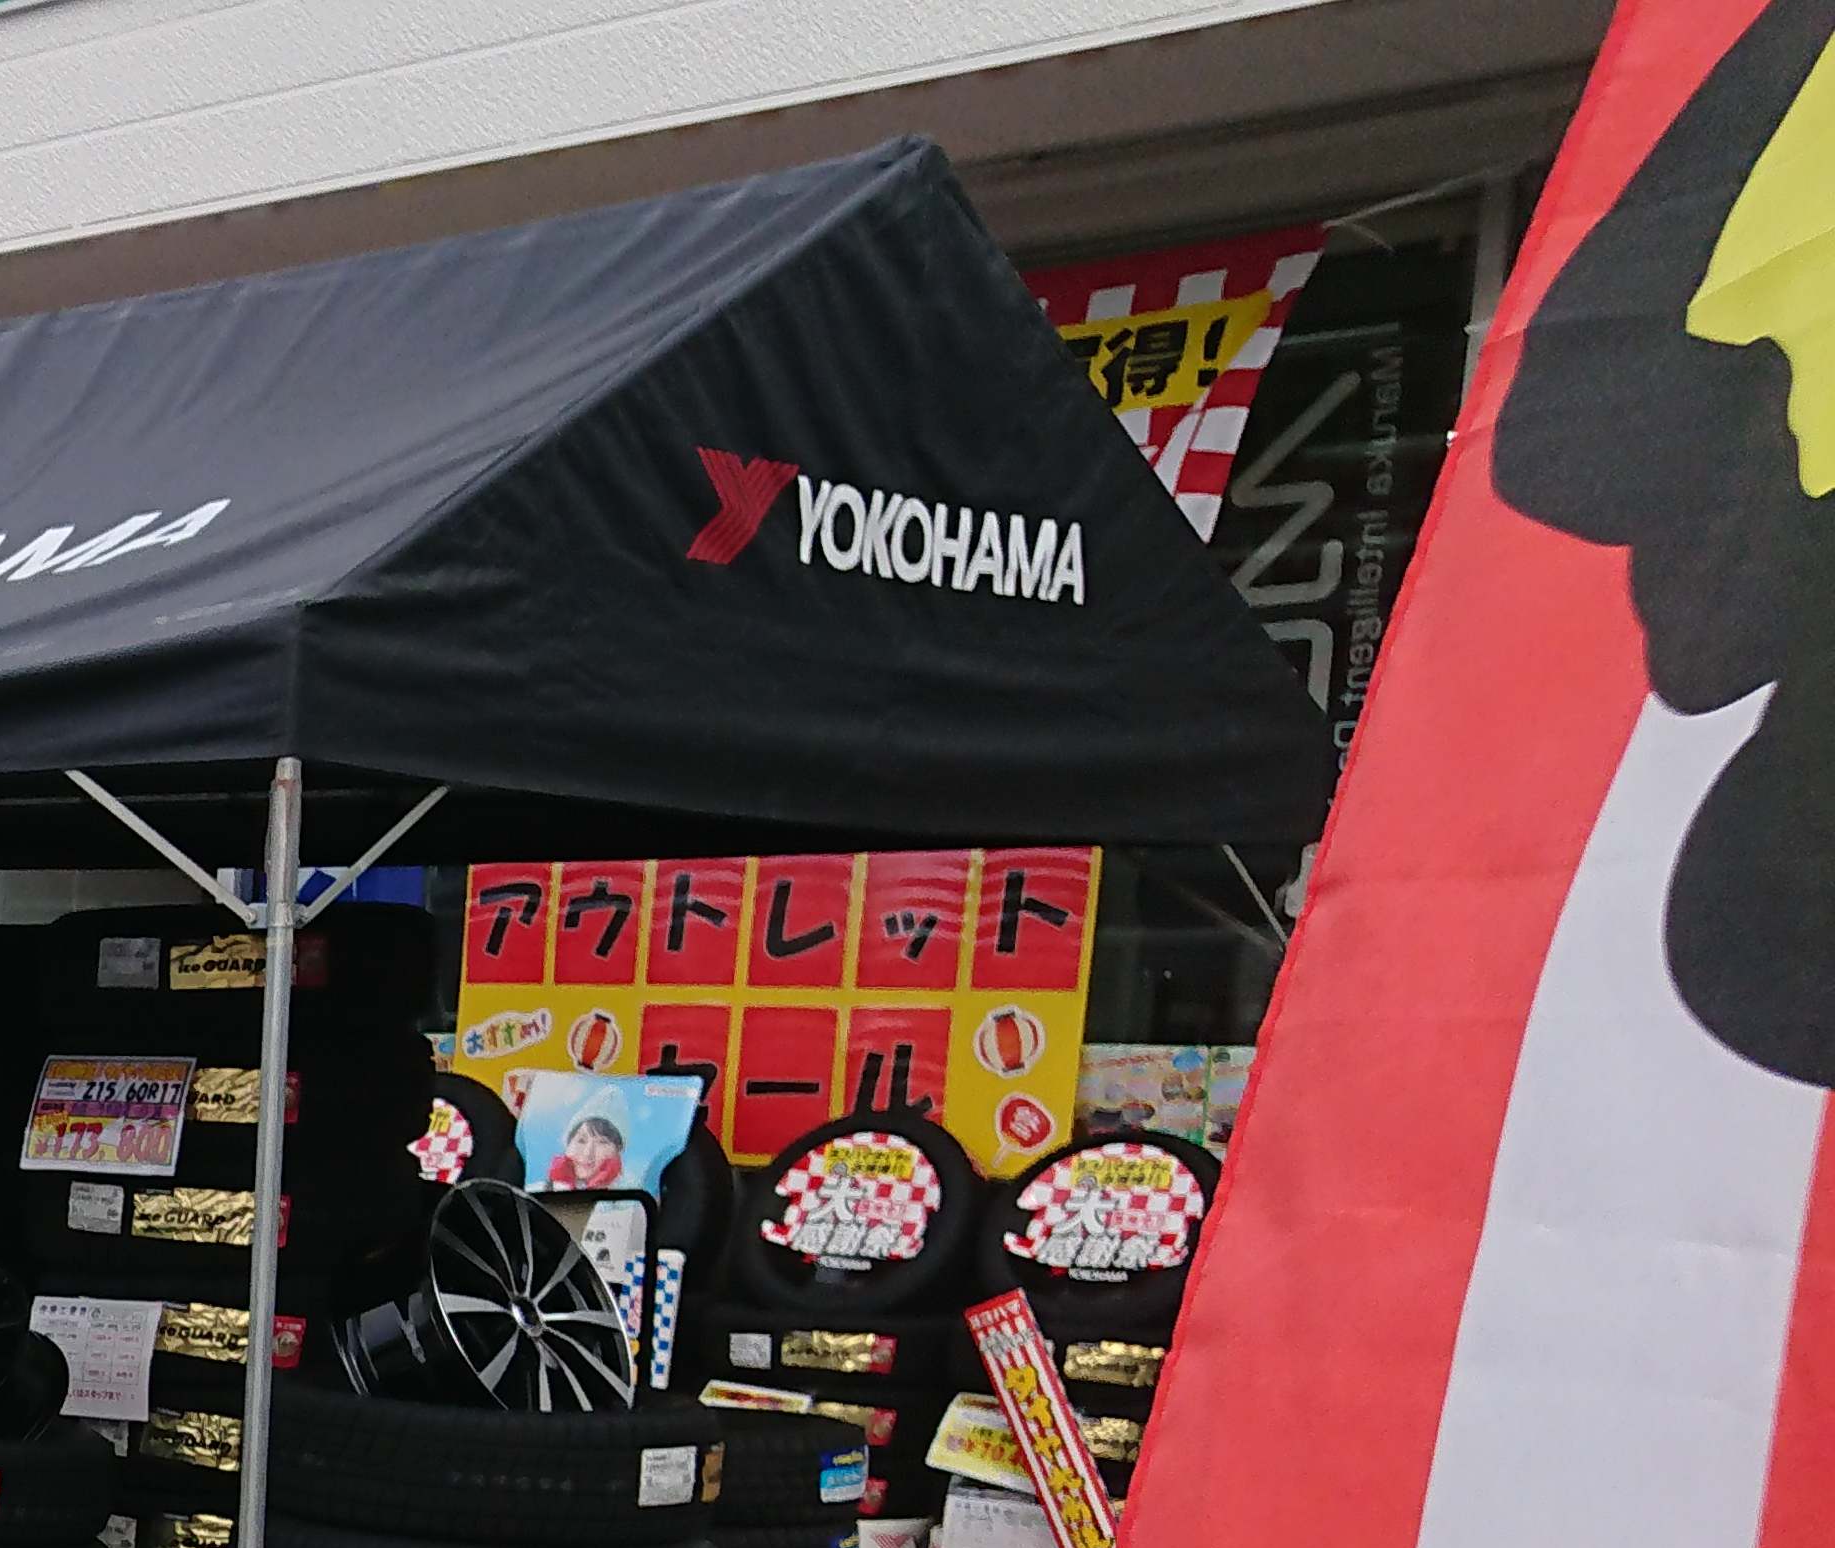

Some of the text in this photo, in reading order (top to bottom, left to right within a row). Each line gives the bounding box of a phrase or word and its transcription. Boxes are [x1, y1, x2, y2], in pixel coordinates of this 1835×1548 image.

[797, 474, 1084, 606] YOKOHAMA
[479, 870, 1070, 962] アウトレット
